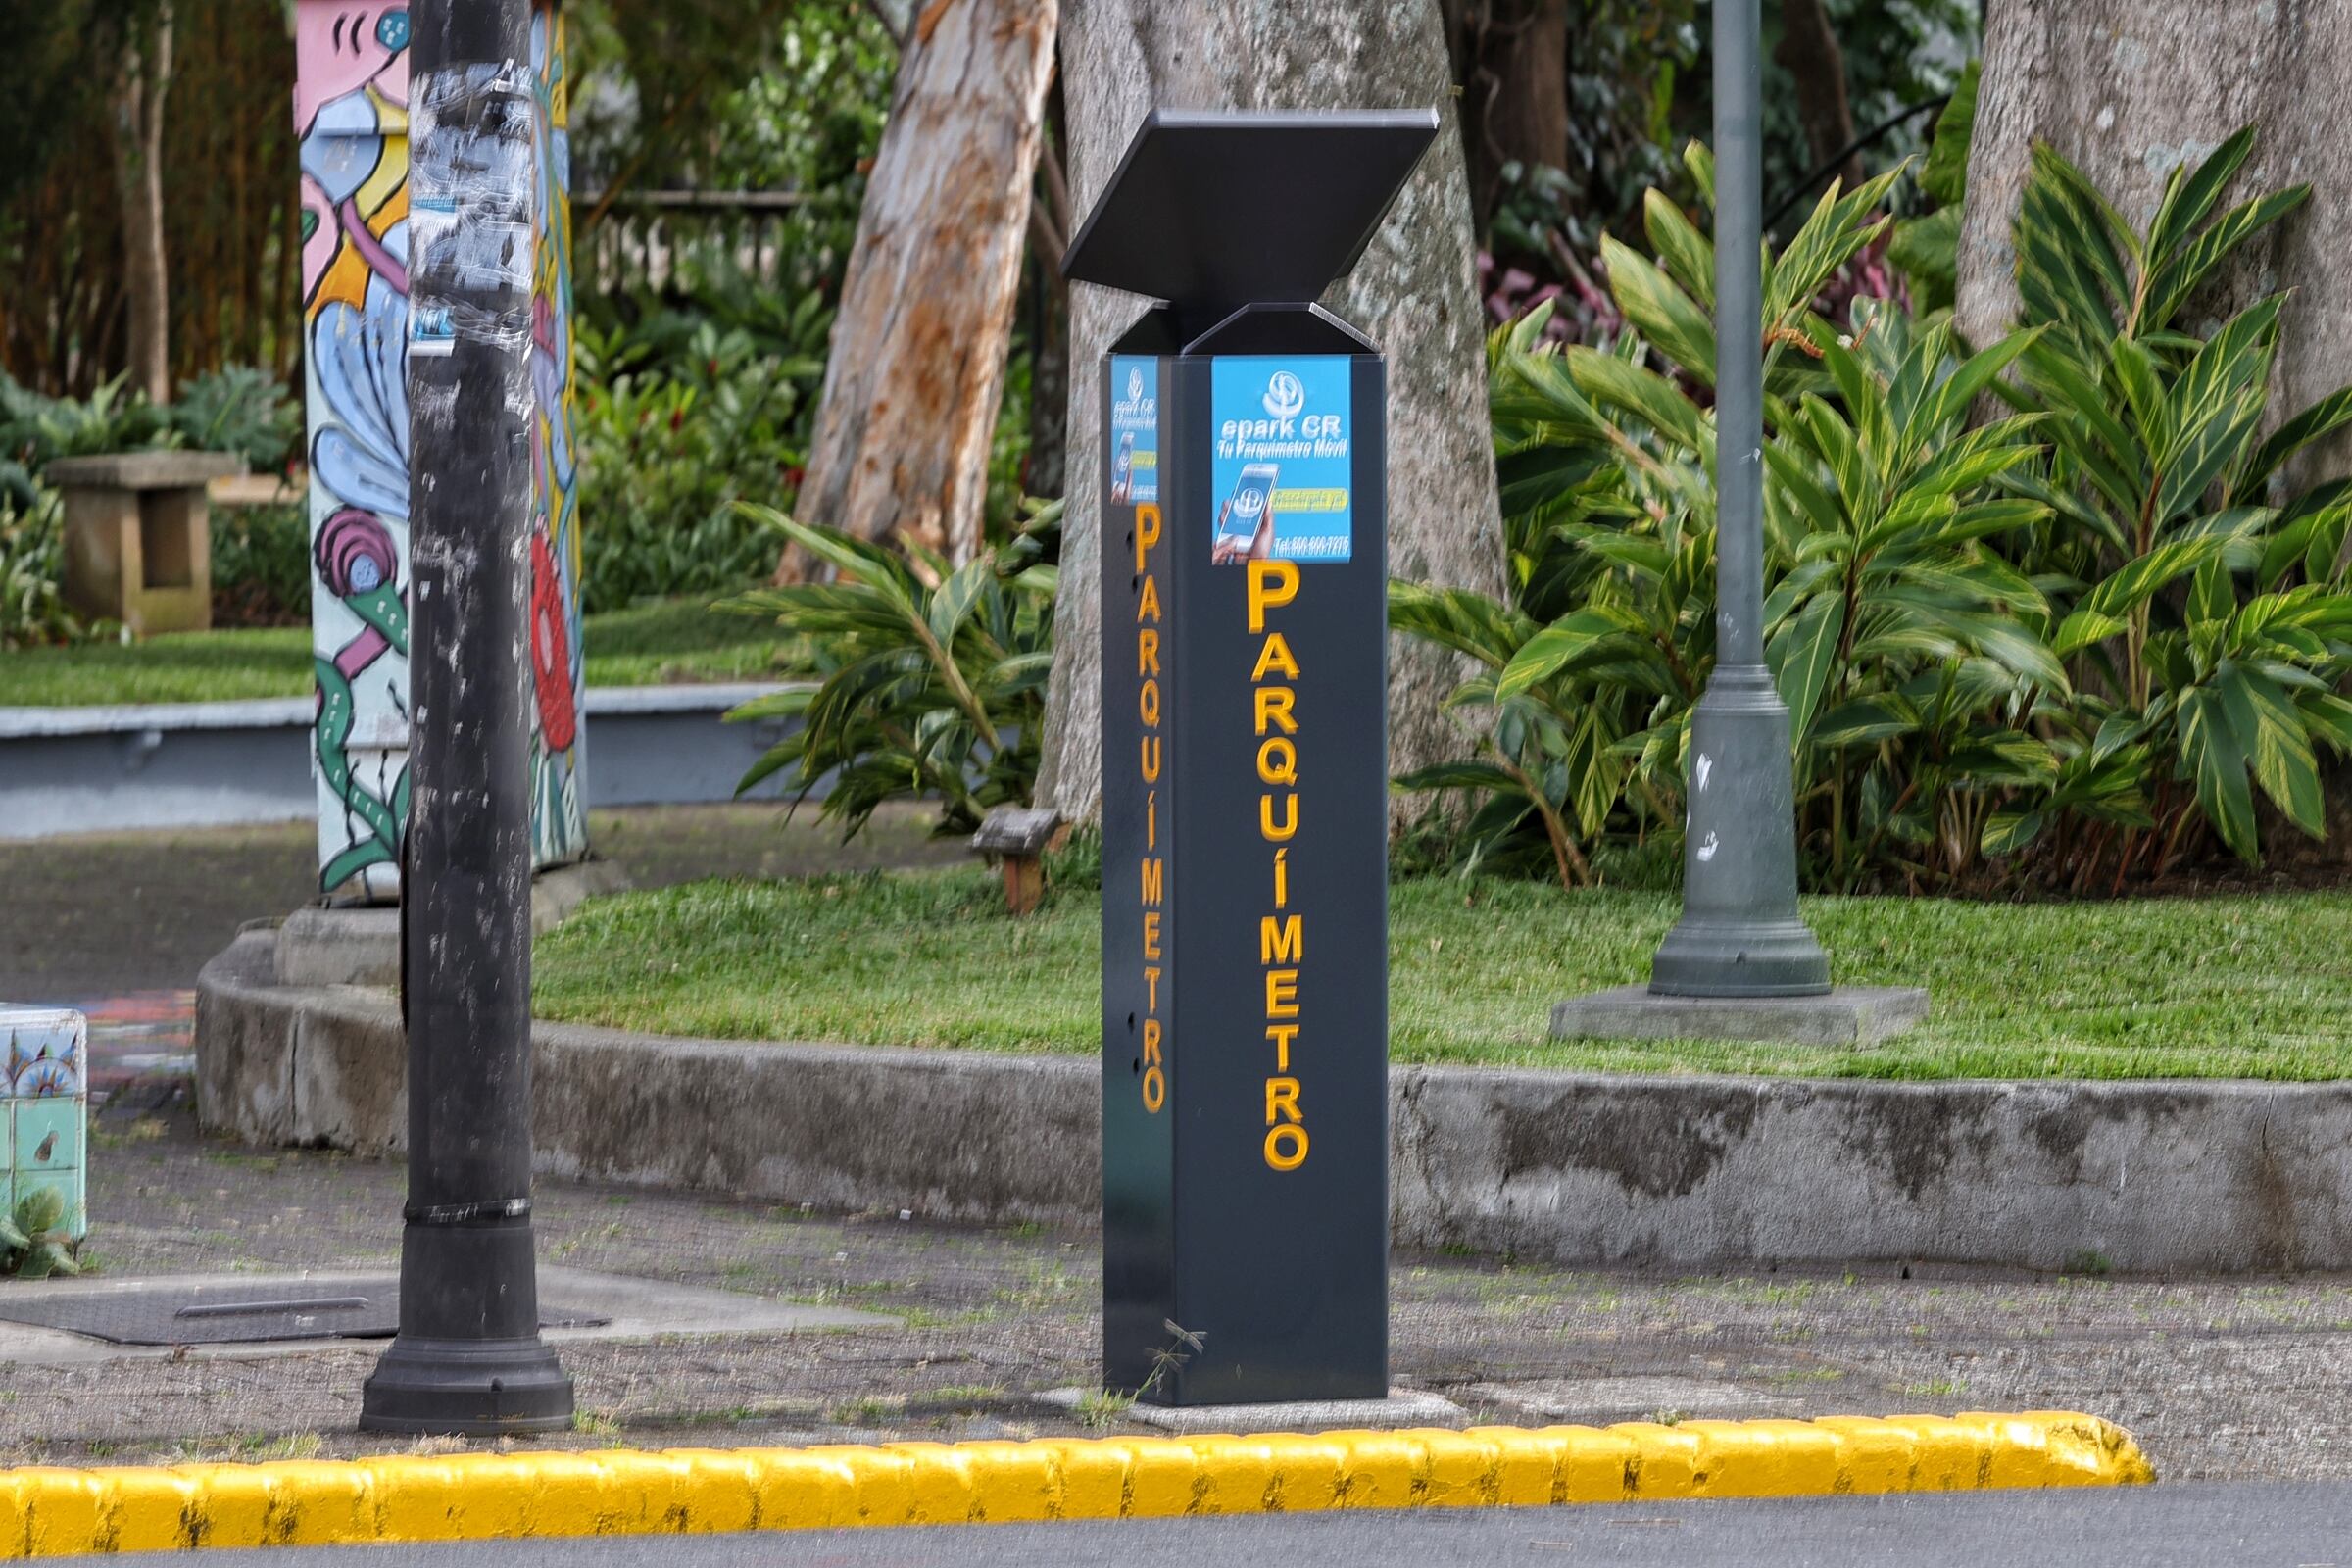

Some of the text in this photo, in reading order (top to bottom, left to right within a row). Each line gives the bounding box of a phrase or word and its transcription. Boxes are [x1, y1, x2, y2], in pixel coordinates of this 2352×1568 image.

[1217, 439, 1234, 460] Tu
[1221, 415, 1342, 441] epark CR
[1135, 504, 1164, 1113] PARQUÍMETRO
[1247, 558, 1310, 1171] PARQUÍMETRO
